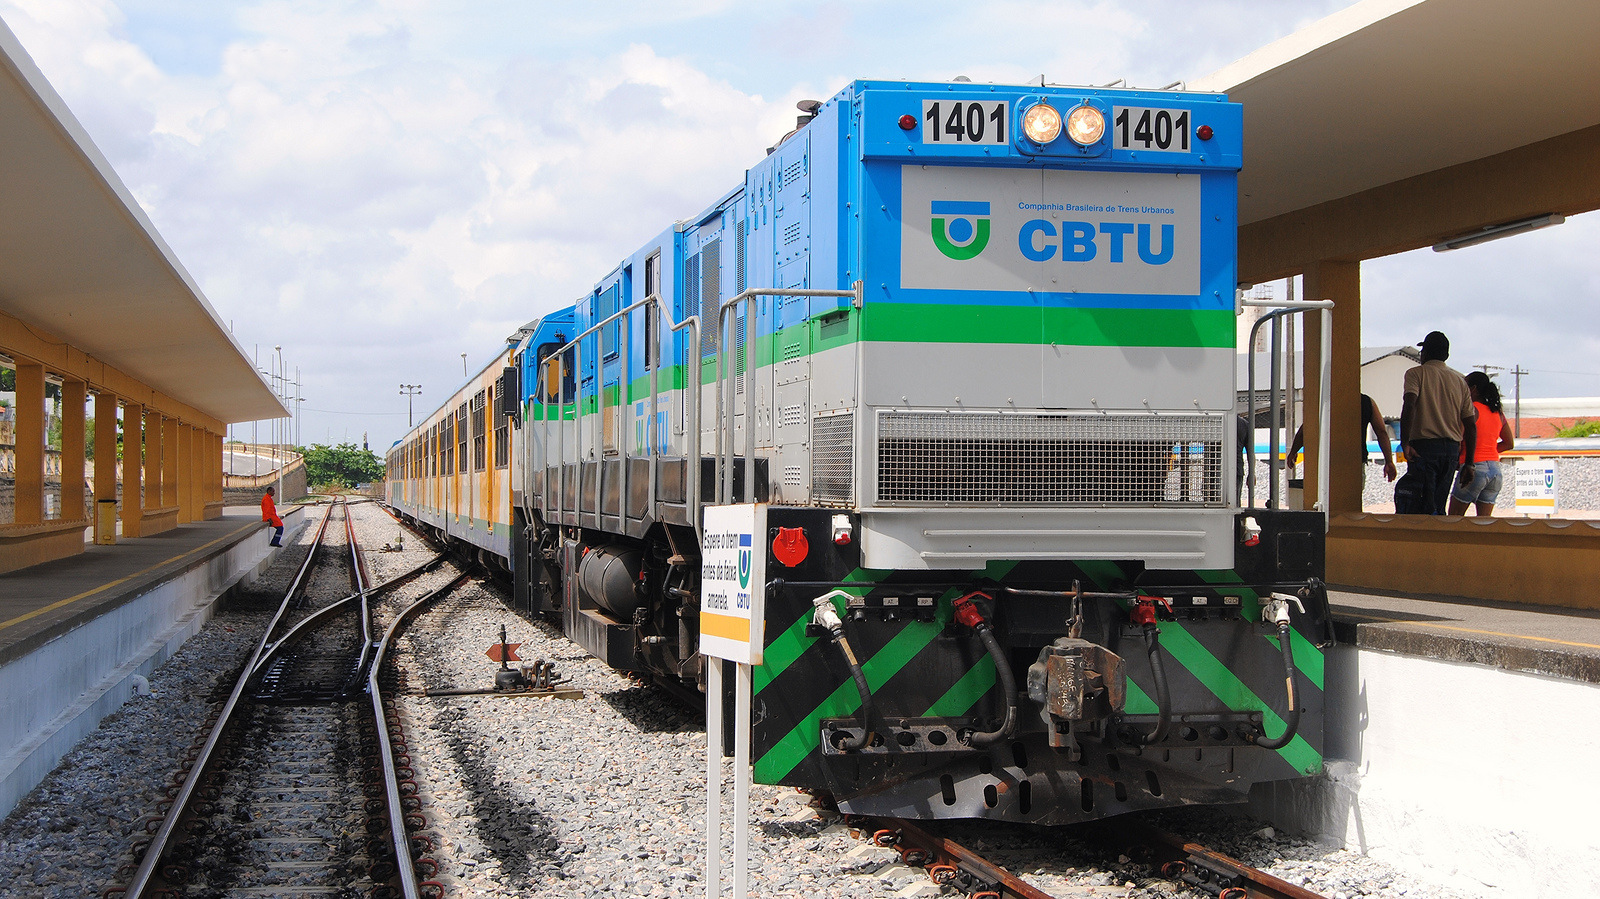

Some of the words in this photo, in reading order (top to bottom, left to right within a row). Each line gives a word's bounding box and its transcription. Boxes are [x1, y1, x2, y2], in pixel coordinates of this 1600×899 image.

[926, 102, 1005, 143] 1401
[1115, 108, 1189, 150] 1401
[1018, 202, 1064, 212] Companhia
[1066, 203, 1104, 212] Brasileira
[1105, 205, 1116, 213] de
[1117, 205, 1139, 213] Trens
[1141, 206, 1175, 214] Urbanos
[1018, 219, 1175, 265] CBTU
[646, 410, 669, 457] CTU
[704, 529, 721, 554] Espere
[721, 533, 726, 549] o
[725, 530, 738, 549] trem
[703, 561, 716, 580] antes
[716, 560, 723, 580] da
[723, 560, 737, 581] faixa
[707, 589, 729, 610] amarela.
[737, 592, 751, 610] CBTU
